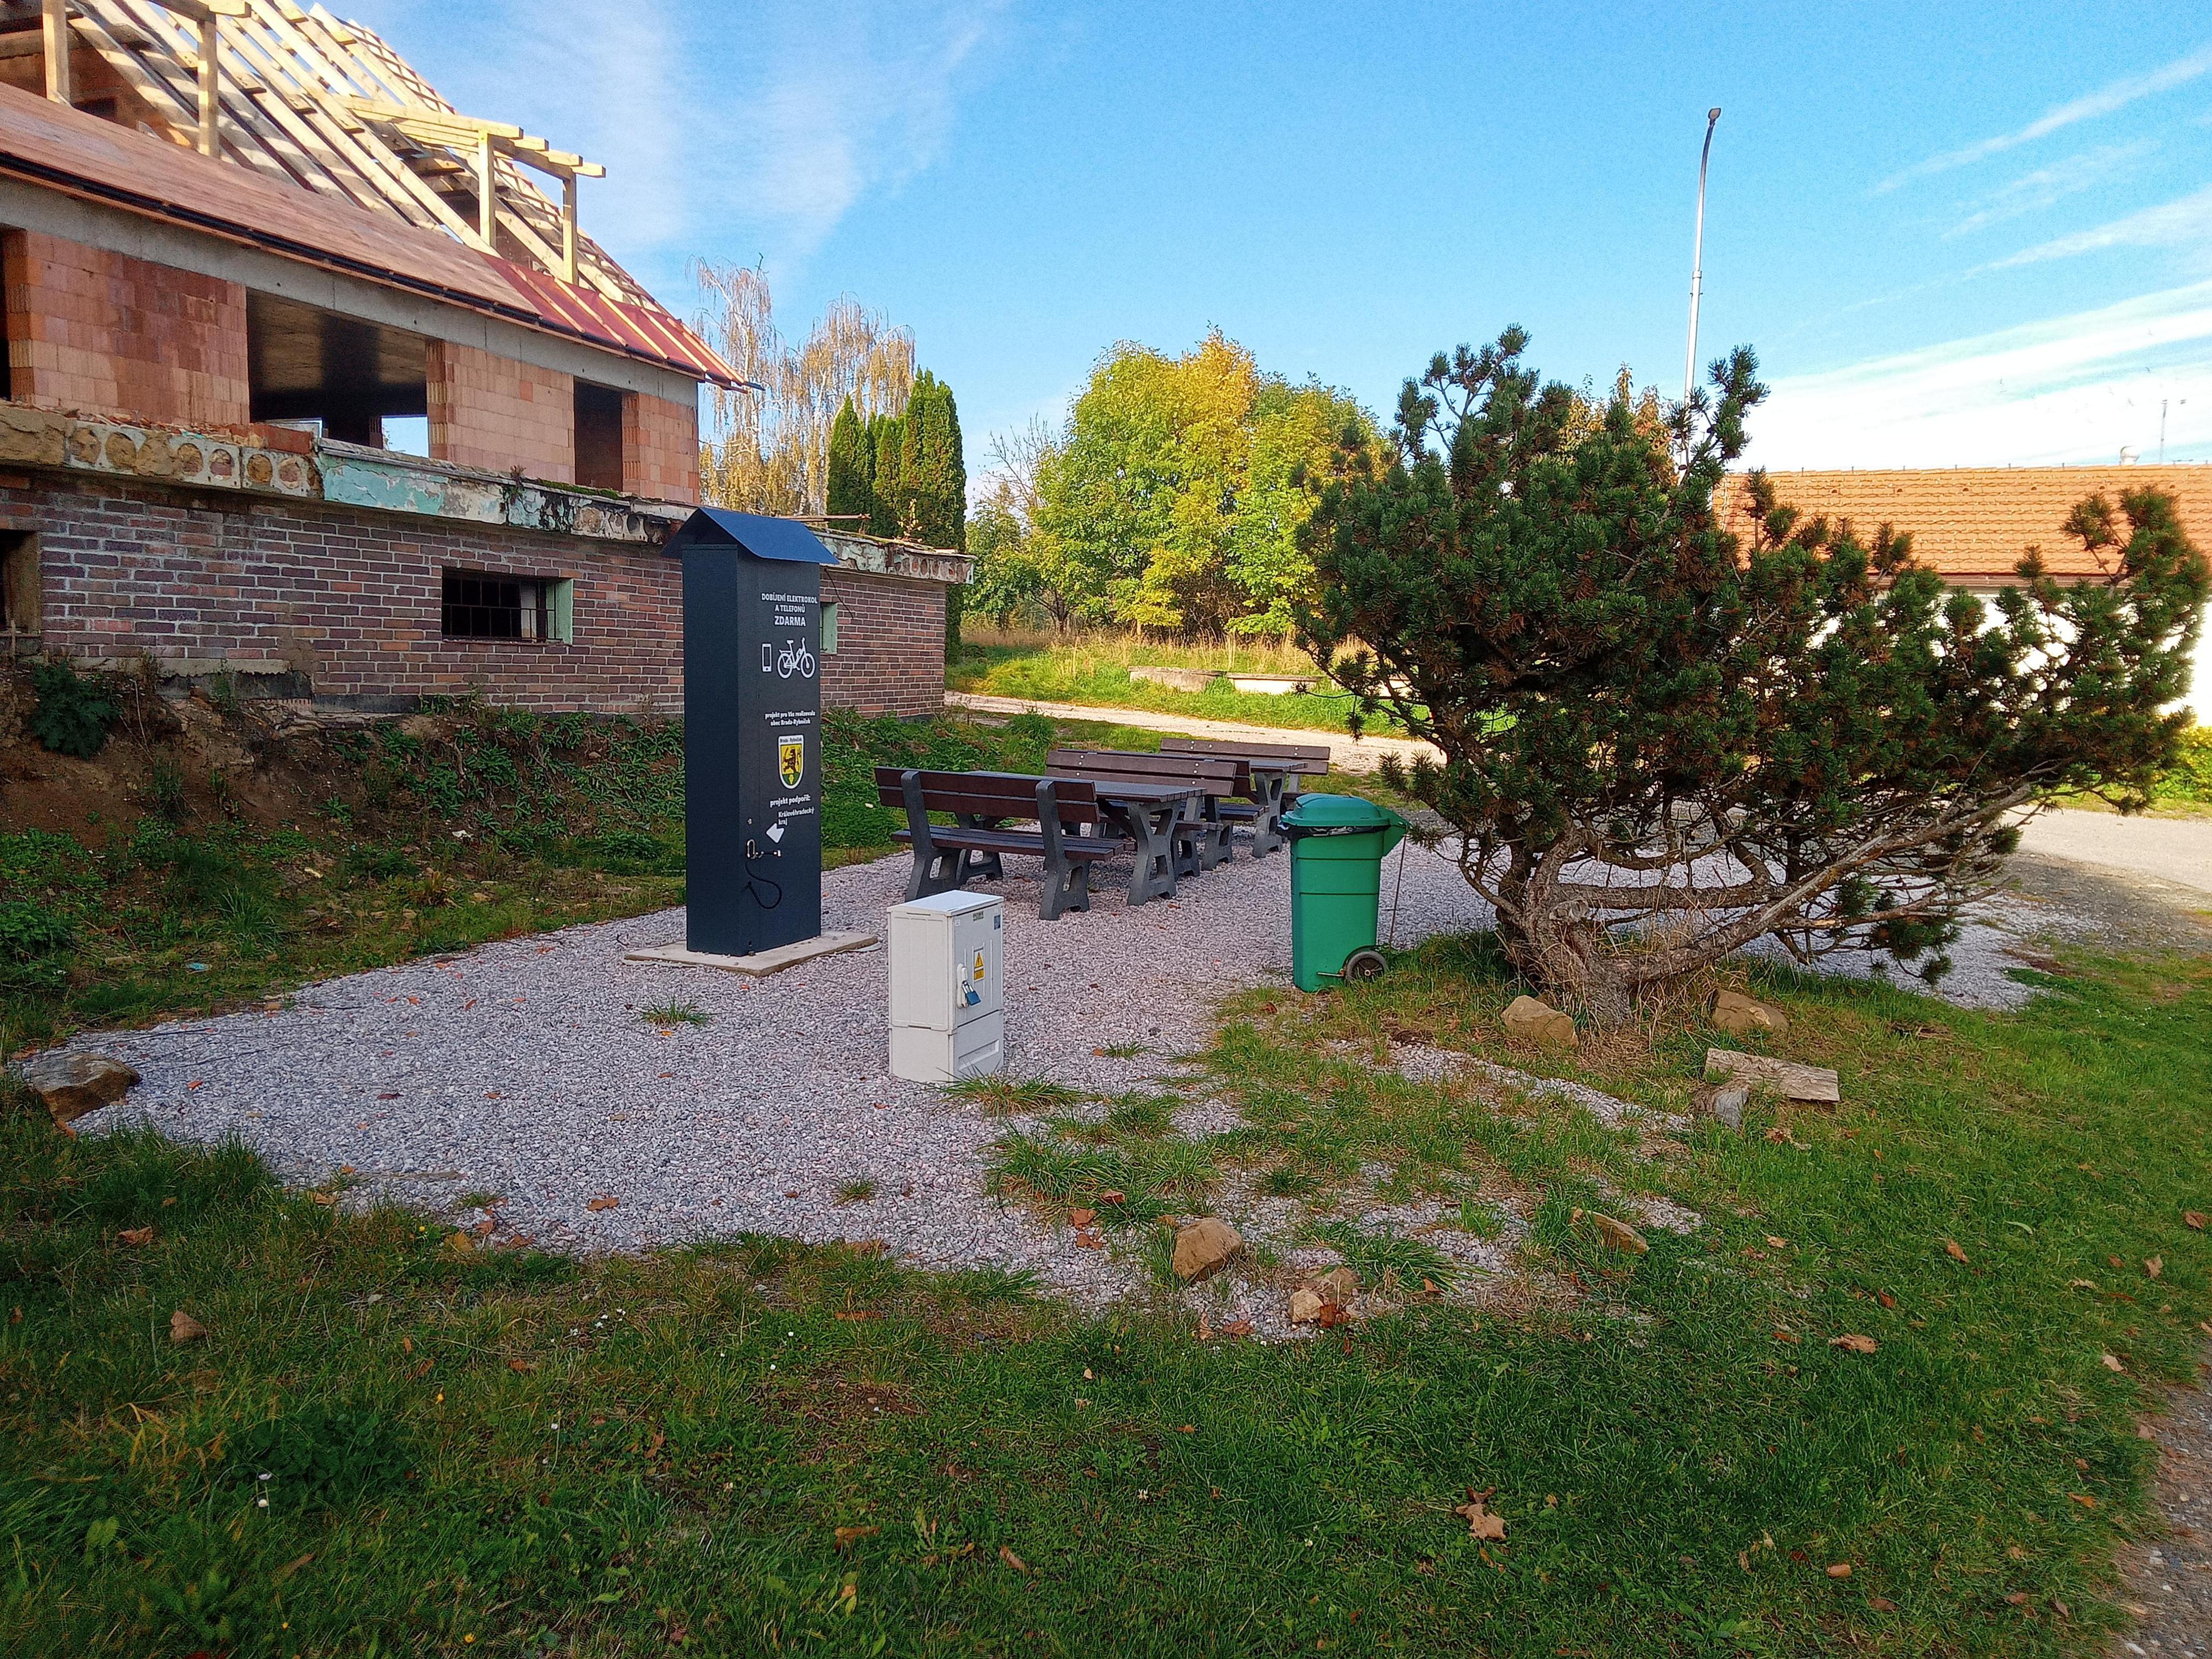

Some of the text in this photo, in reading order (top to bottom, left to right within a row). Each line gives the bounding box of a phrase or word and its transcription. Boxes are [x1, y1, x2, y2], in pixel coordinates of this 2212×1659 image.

[761, 592, 817, 604] DOBÍJENÍ ELEKTROKOL
[780, 604, 805, 613] TELEFONŮ
[774, 615, 806, 627] ZDARMA
[770, 797, 788, 807] projekt
[778, 807, 815, 818] Královéhradecký
